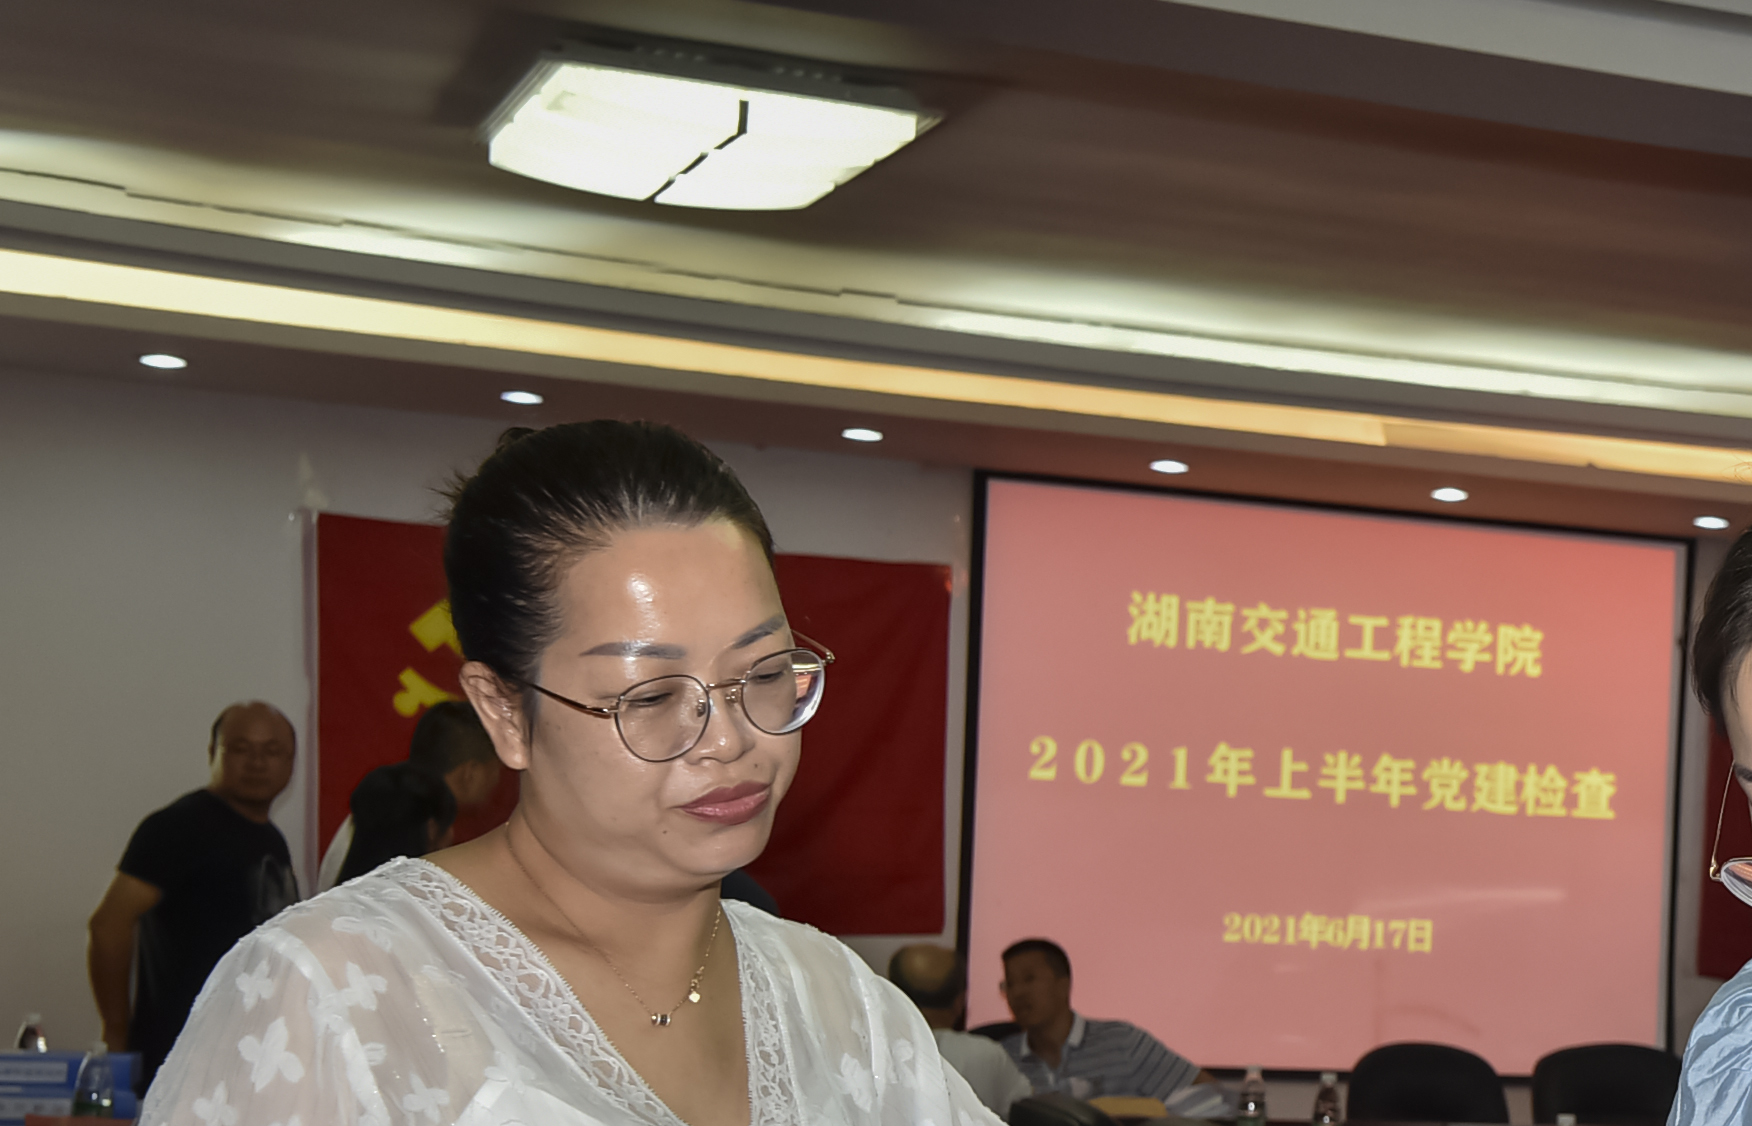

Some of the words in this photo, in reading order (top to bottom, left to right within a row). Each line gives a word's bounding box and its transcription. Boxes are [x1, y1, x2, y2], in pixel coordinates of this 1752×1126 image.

[1128, 592, 1543, 677] 湖南交通工程学院
[1028, 736, 1617, 820] 2021年上半年党建检查
[1223, 911, 1433, 953] 2021年6月17日
